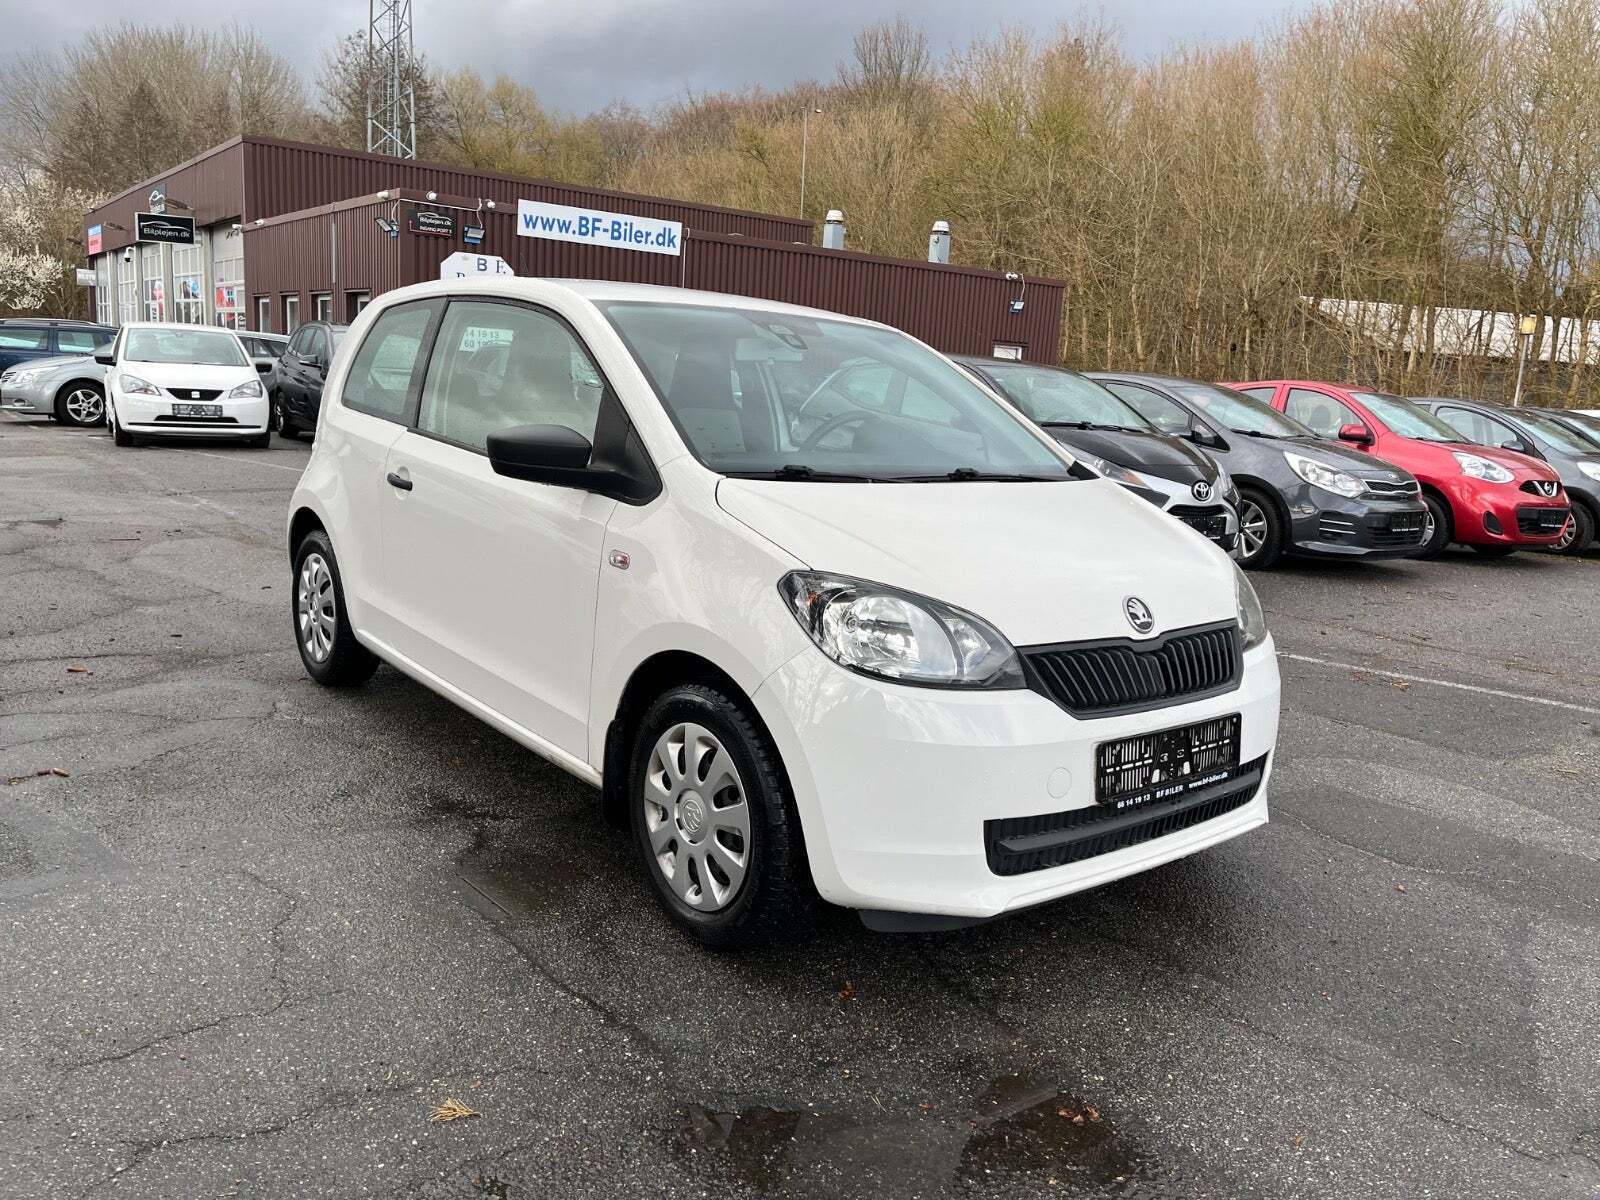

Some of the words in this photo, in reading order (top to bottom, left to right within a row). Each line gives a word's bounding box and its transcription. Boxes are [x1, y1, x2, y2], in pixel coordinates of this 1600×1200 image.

[143, 227, 191, 238] Bilplejen.dk
[523, 213, 677, 248] www.BF-Biler.dk
[476, 257, 488, 271] B
[1164, 784, 1184, 796] BILER
